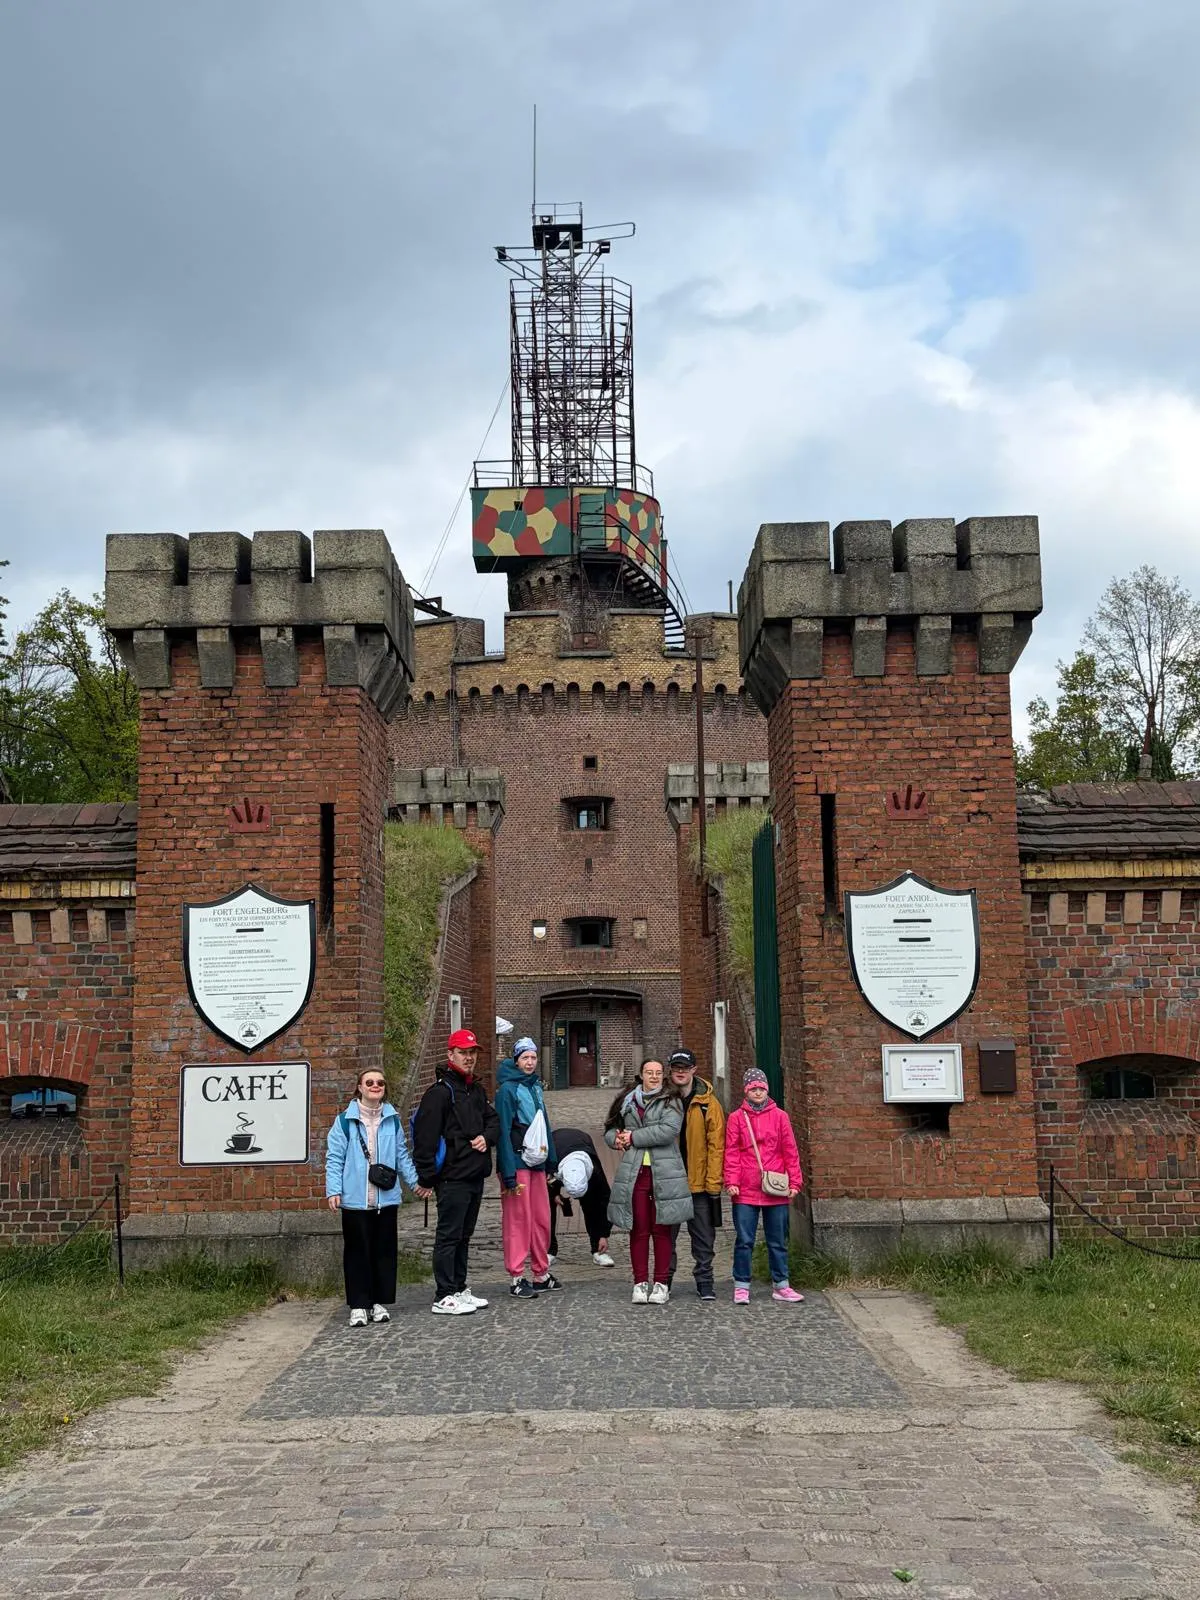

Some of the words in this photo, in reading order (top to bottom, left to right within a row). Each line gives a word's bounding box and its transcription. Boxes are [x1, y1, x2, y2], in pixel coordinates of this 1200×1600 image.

[212, 908, 233, 916] FORT
[235, 906, 289, 915] ENGELSBURG
[202, 1069, 288, 1103] CAFÉ
